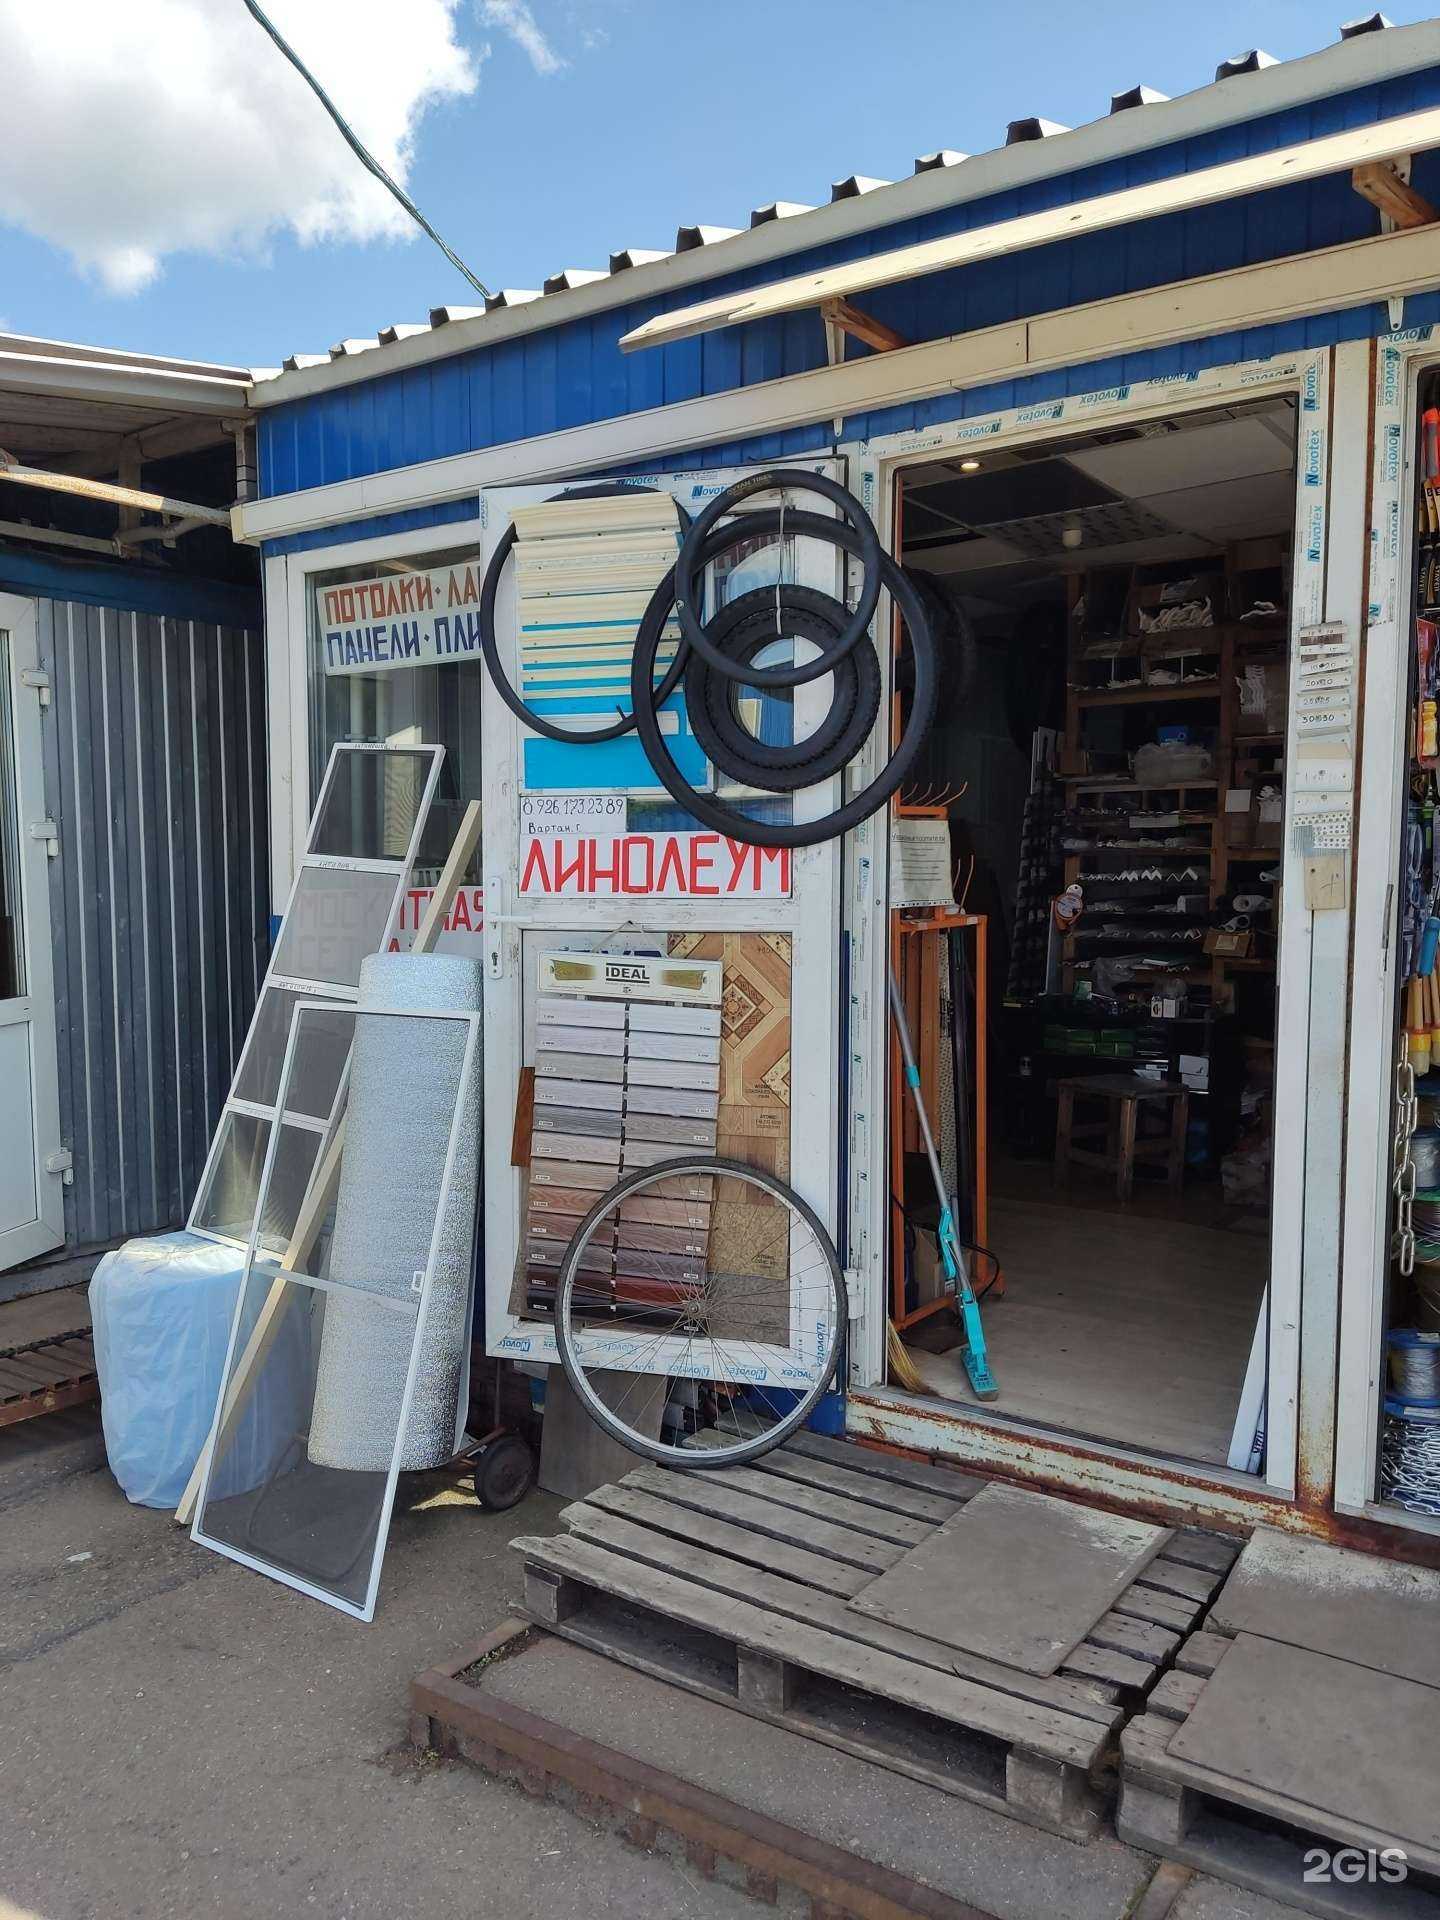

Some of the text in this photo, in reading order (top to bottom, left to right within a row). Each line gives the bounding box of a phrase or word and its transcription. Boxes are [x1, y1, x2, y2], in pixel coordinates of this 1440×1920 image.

[1016, 404, 1065, 424] Novotex
[1079, 385, 1132, 404] Novotex
[956, 421, 1002, 441] Novotex
[1305, 429, 1321, 486] Novotex
[1307, 505, 1322, 562] Novotex
[324, 565, 480, 626] ПОТОЛКИ ЛА
[326, 620, 421, 667] ПАНЕЛИ
[520, 835, 790, 894] ЛИНОЛЕУМ
[605, 966, 651, 981] IDEAL
